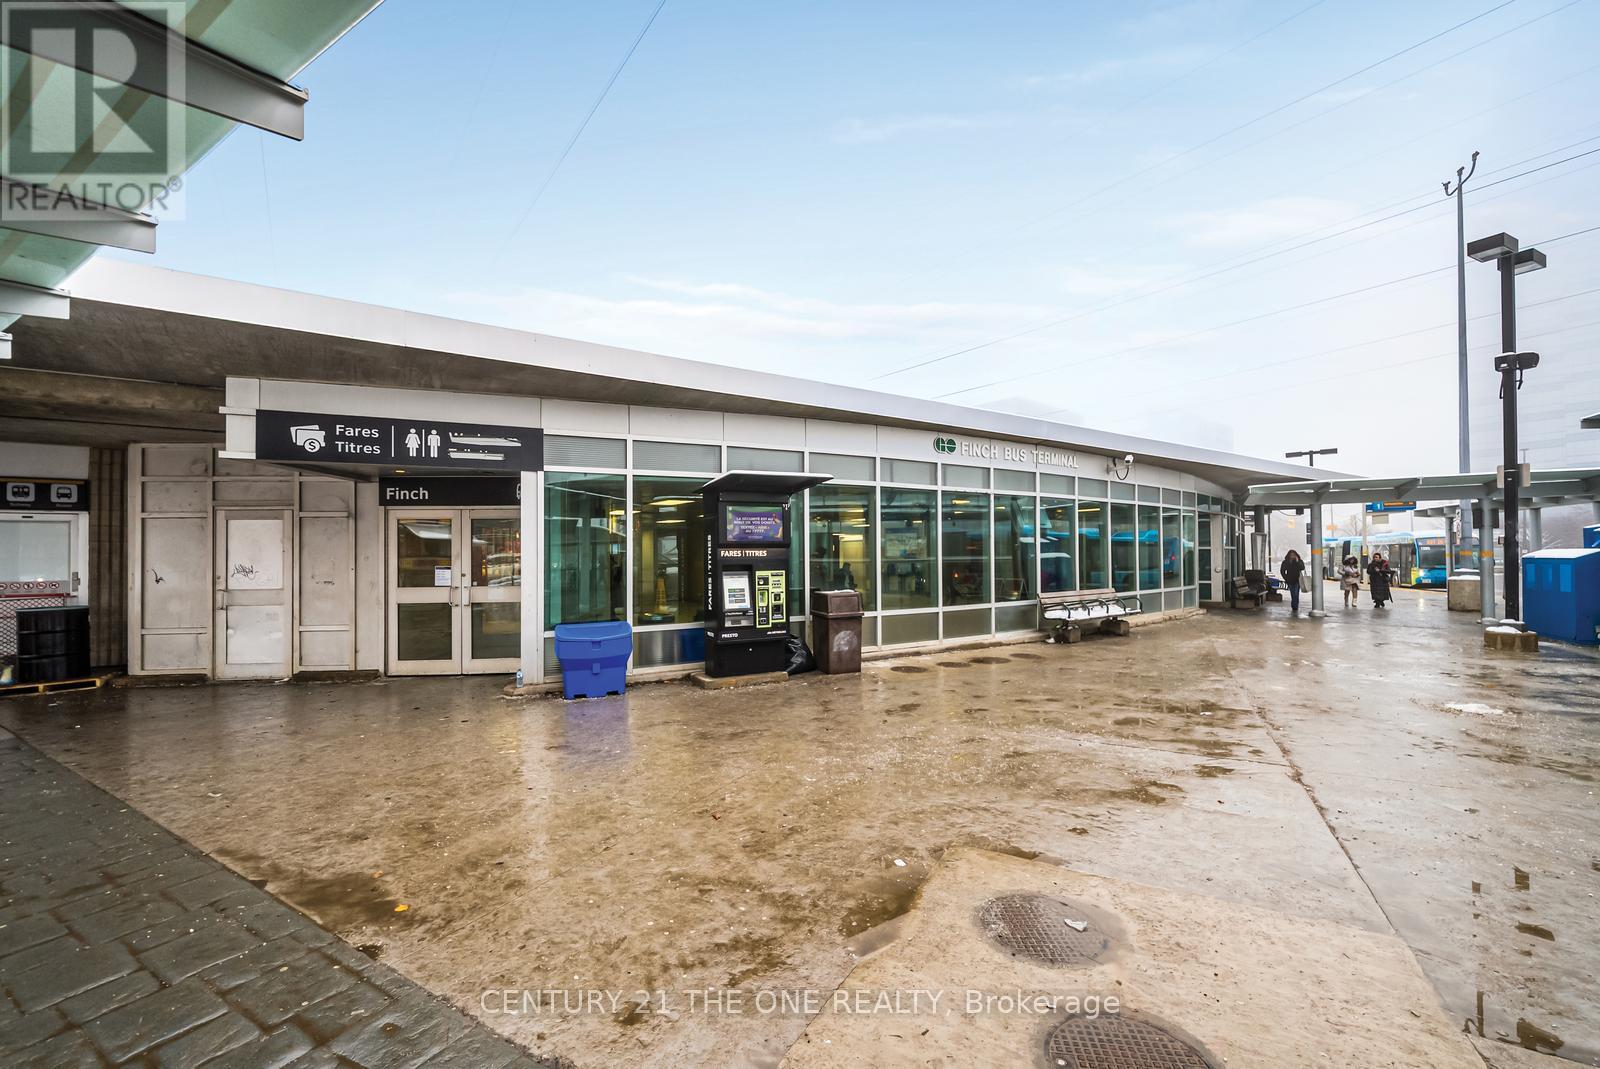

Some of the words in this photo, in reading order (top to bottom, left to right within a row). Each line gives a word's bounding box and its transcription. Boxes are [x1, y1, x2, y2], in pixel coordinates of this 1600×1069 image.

[335, 424, 380, 438] Fares
[335, 441, 381, 455] Titres
[960, 441, 998, 459] FINCH
[1003, 447, 1027, 462] BUS
[1031, 449, 1080, 468] TERMINAL
[386, 486, 429, 501] Finch
